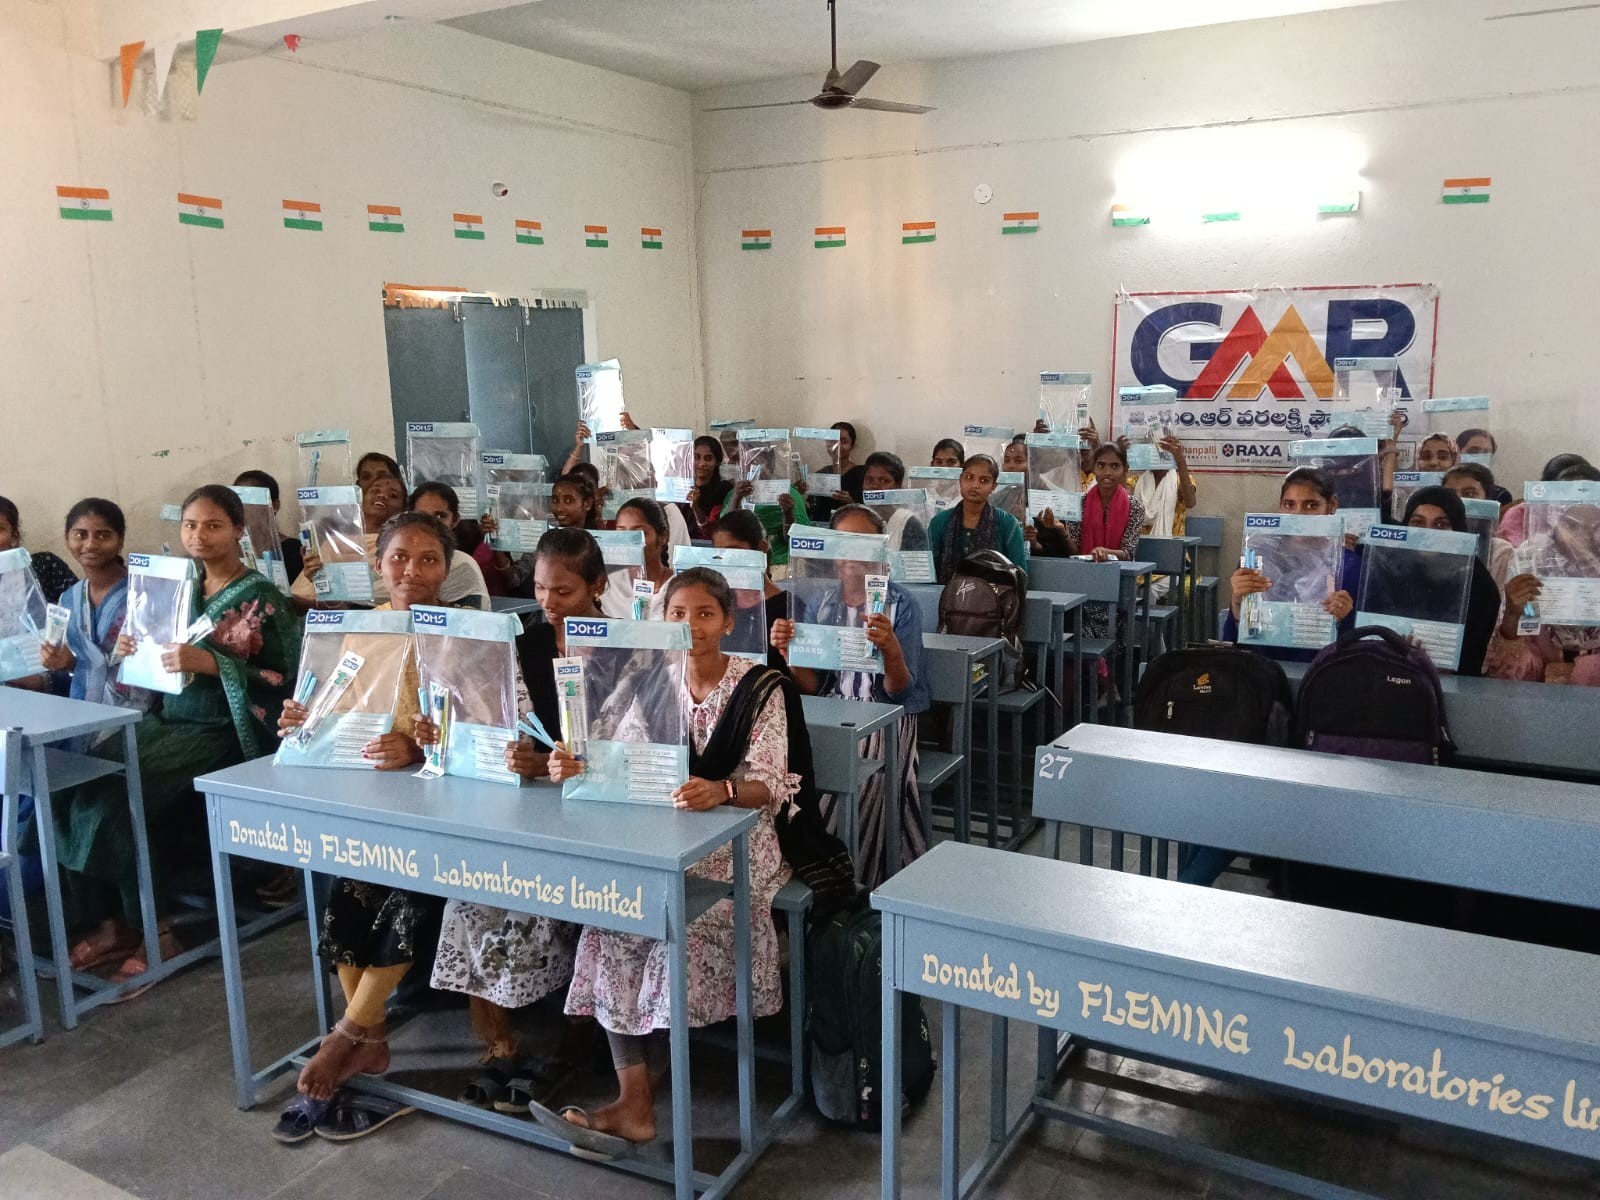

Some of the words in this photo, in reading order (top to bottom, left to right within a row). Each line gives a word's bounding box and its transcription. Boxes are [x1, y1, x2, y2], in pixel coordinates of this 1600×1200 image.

[1130, 299, 1415, 401] GMR
[409, 424, 433, 432] DOMS
[1236, 444, 1282, 457] RAXA
[483, 456, 503, 464] DOMS
[298, 490, 318, 498] DOMS
[864, 492, 885, 500] DOMS
[1248, 517, 1280, 527] DOMS
[1371, 528, 1407, 540] DOMS
[792, 539, 824, 550] DOMS
[129, 556, 149, 566] DOMS
[308, 612, 344, 624] DOMS
[414, 613, 447, 625] DOMS
[568, 623, 607, 636] DOMS
[559, 666, 580, 674] DOMS
[1038, 752, 1073, 781] 27
[230, 819, 288, 853] Donated
[292, 824, 312, 863] by
[320, 833, 420, 879] FLEMING
[433, 855, 565, 906] Laboratories
[570, 875, 645, 920] limited
[921, 952, 1021, 1000] Donated
[1026, 971, 1061, 1018] by
[1078, 980, 1251, 1055] FLEMING
[1283, 1026, 1555, 1120] Laboratories
[1562, 1079, 1600, 1132] li
